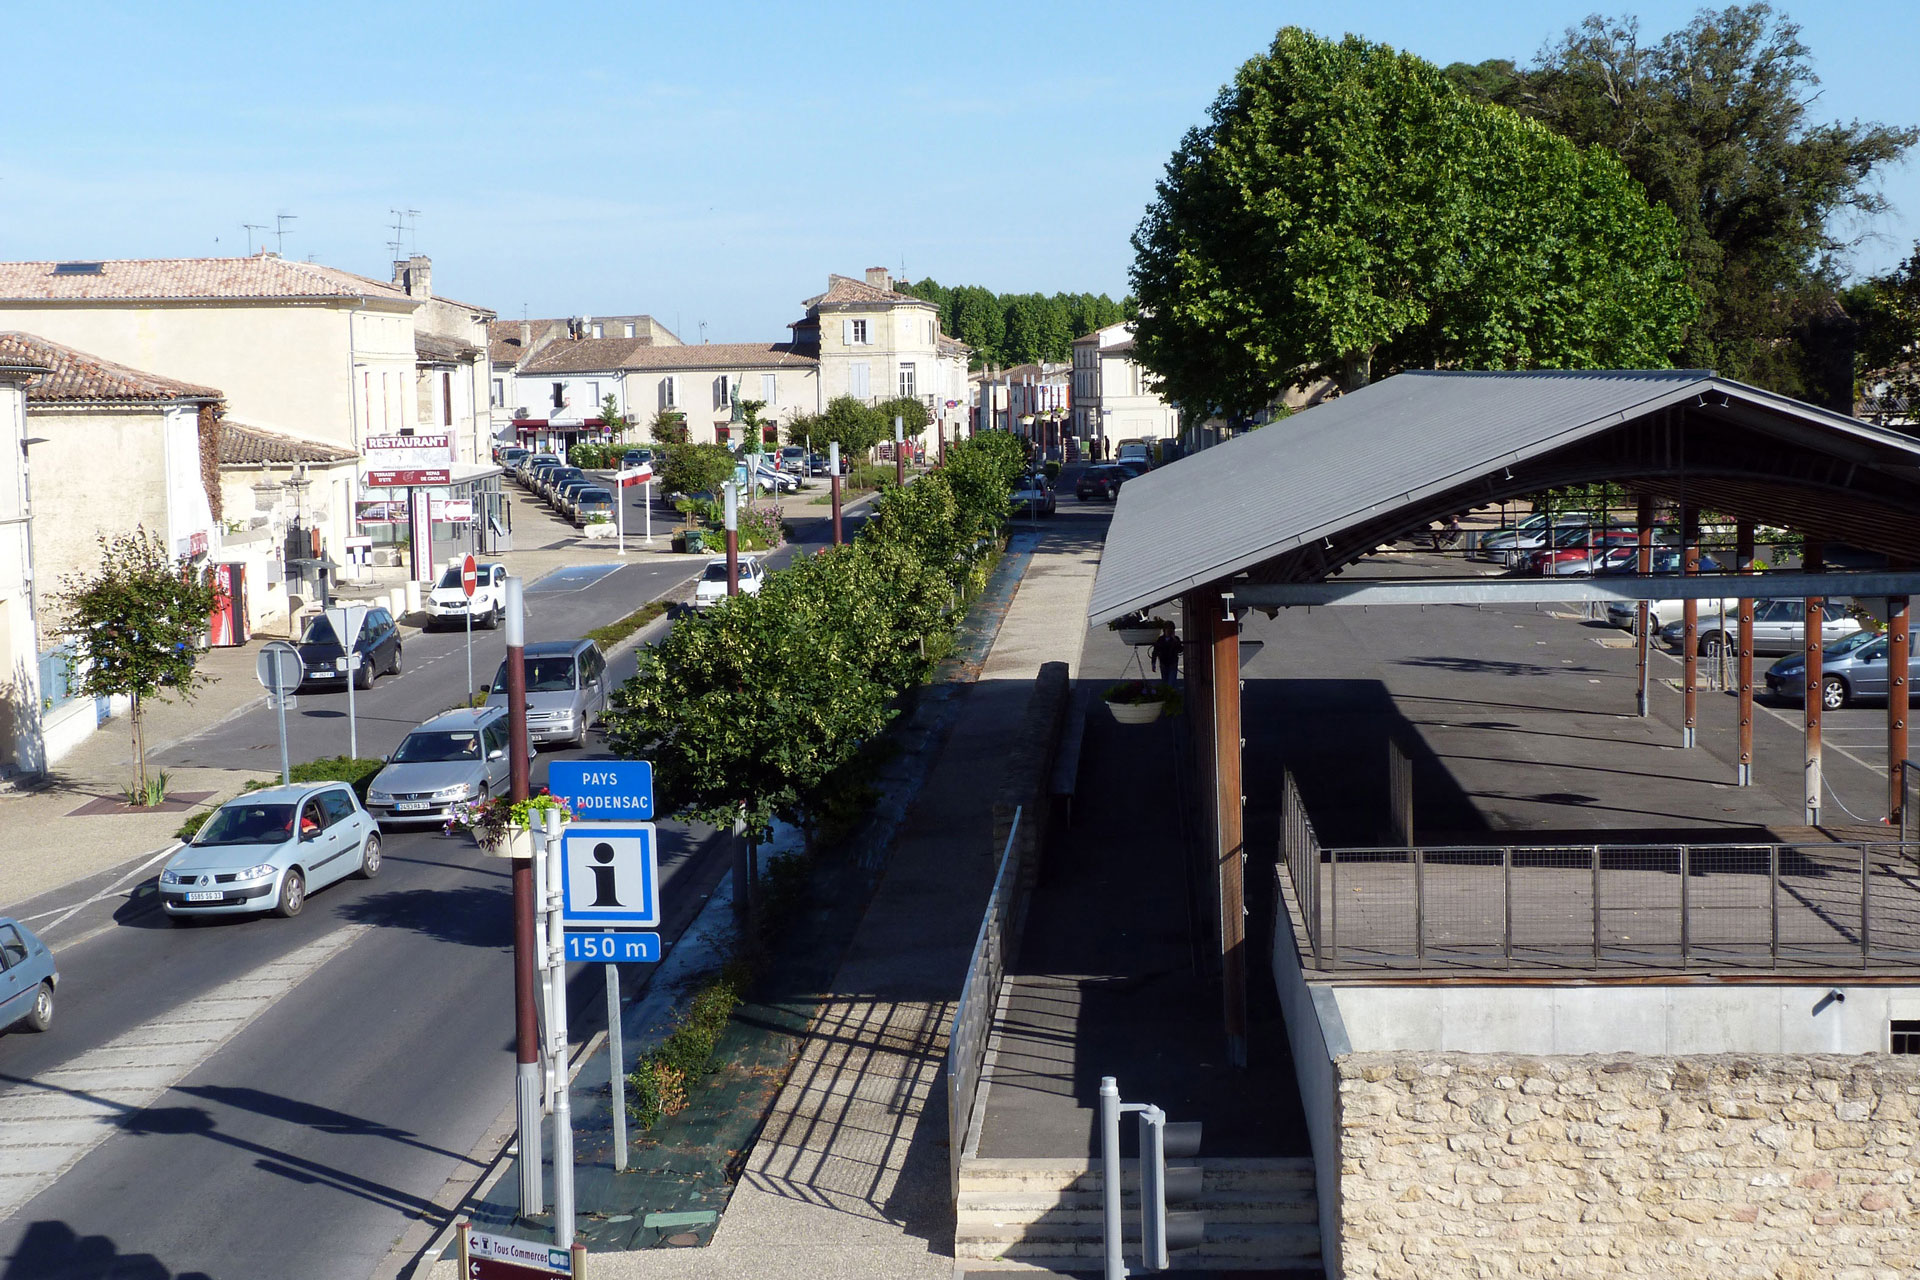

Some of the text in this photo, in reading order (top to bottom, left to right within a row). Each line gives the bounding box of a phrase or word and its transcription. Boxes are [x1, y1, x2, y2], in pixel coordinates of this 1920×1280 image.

[368, 437, 446, 448] RESTAURANT
[582, 772, 618, 786] PAYS
[570, 937, 648, 958] 150 m
[494, 1242, 509, 1255] Tous
[510, 1245, 548, 1263] Commerces
